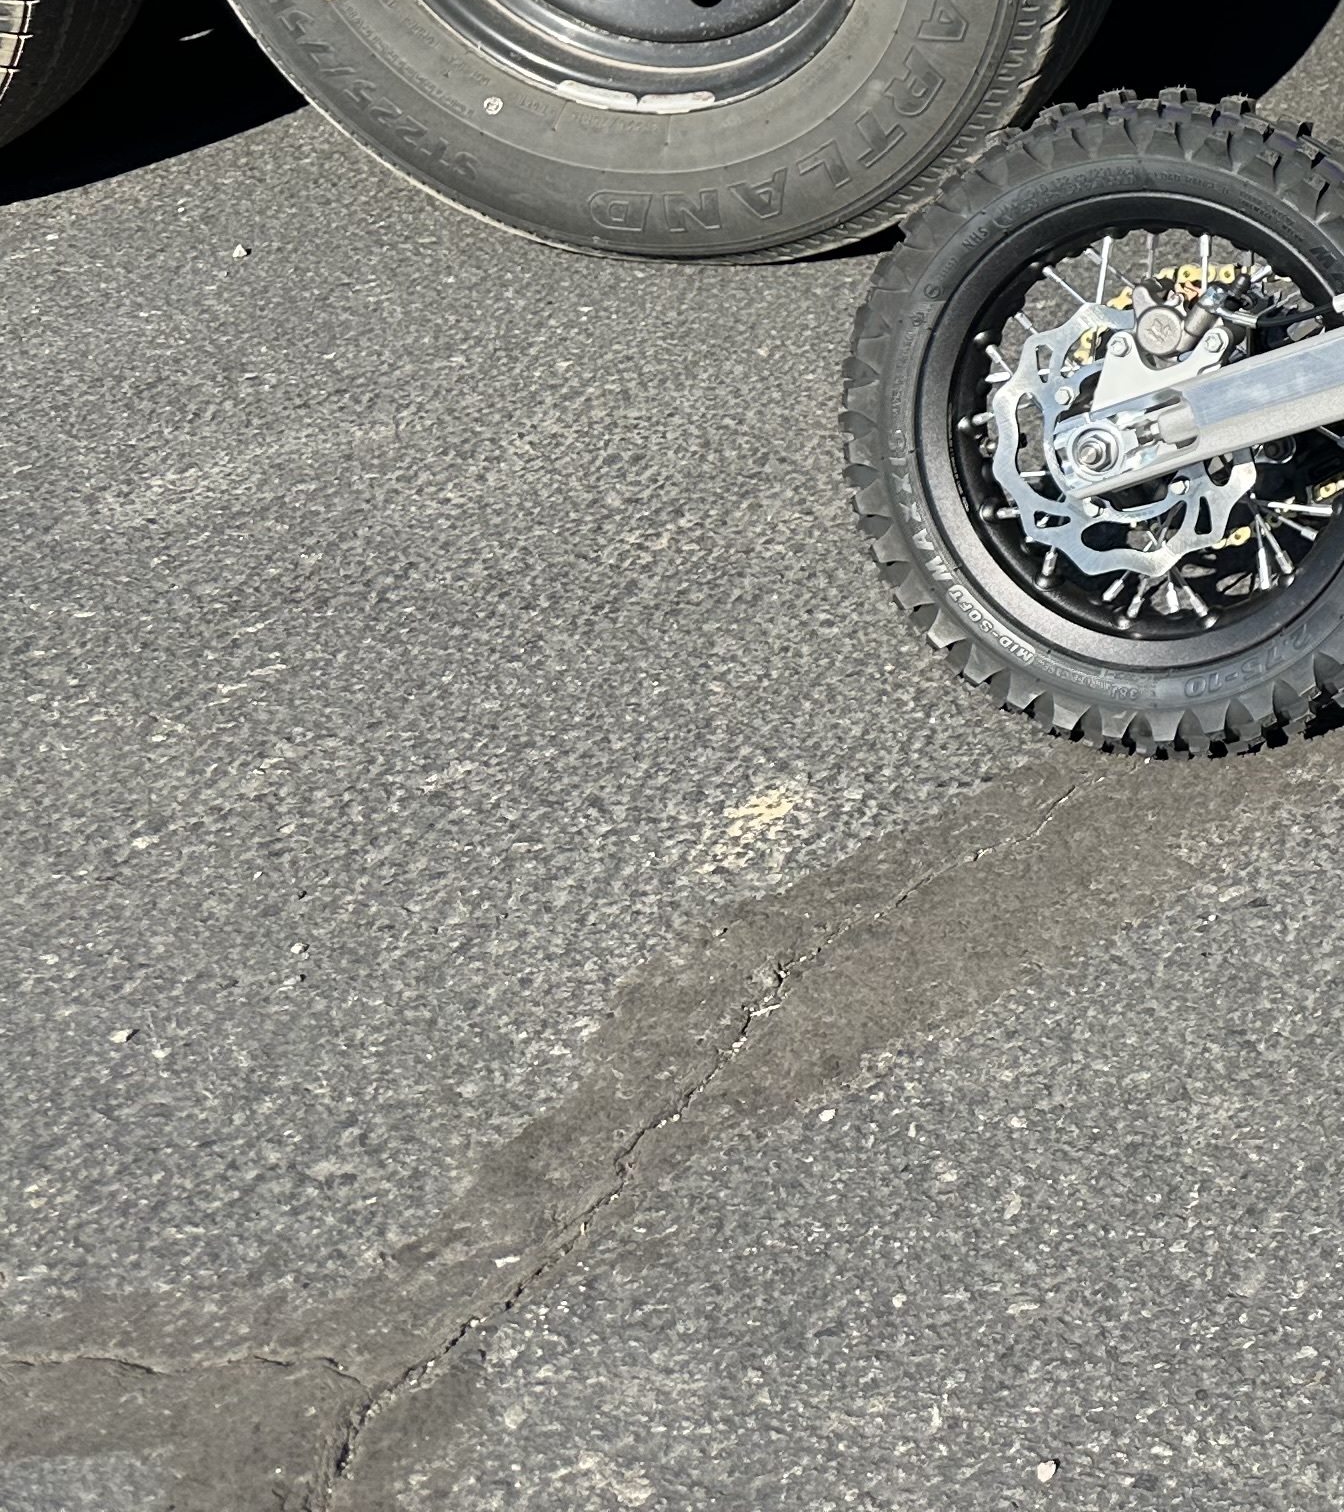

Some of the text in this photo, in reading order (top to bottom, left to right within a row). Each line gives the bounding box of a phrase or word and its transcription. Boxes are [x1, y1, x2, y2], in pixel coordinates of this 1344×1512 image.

[960, 226, 990, 252] NHS
[948, 585, 1034, 663] MID-SOFT
[1183, 621, 1317, 698] 2.75-10
